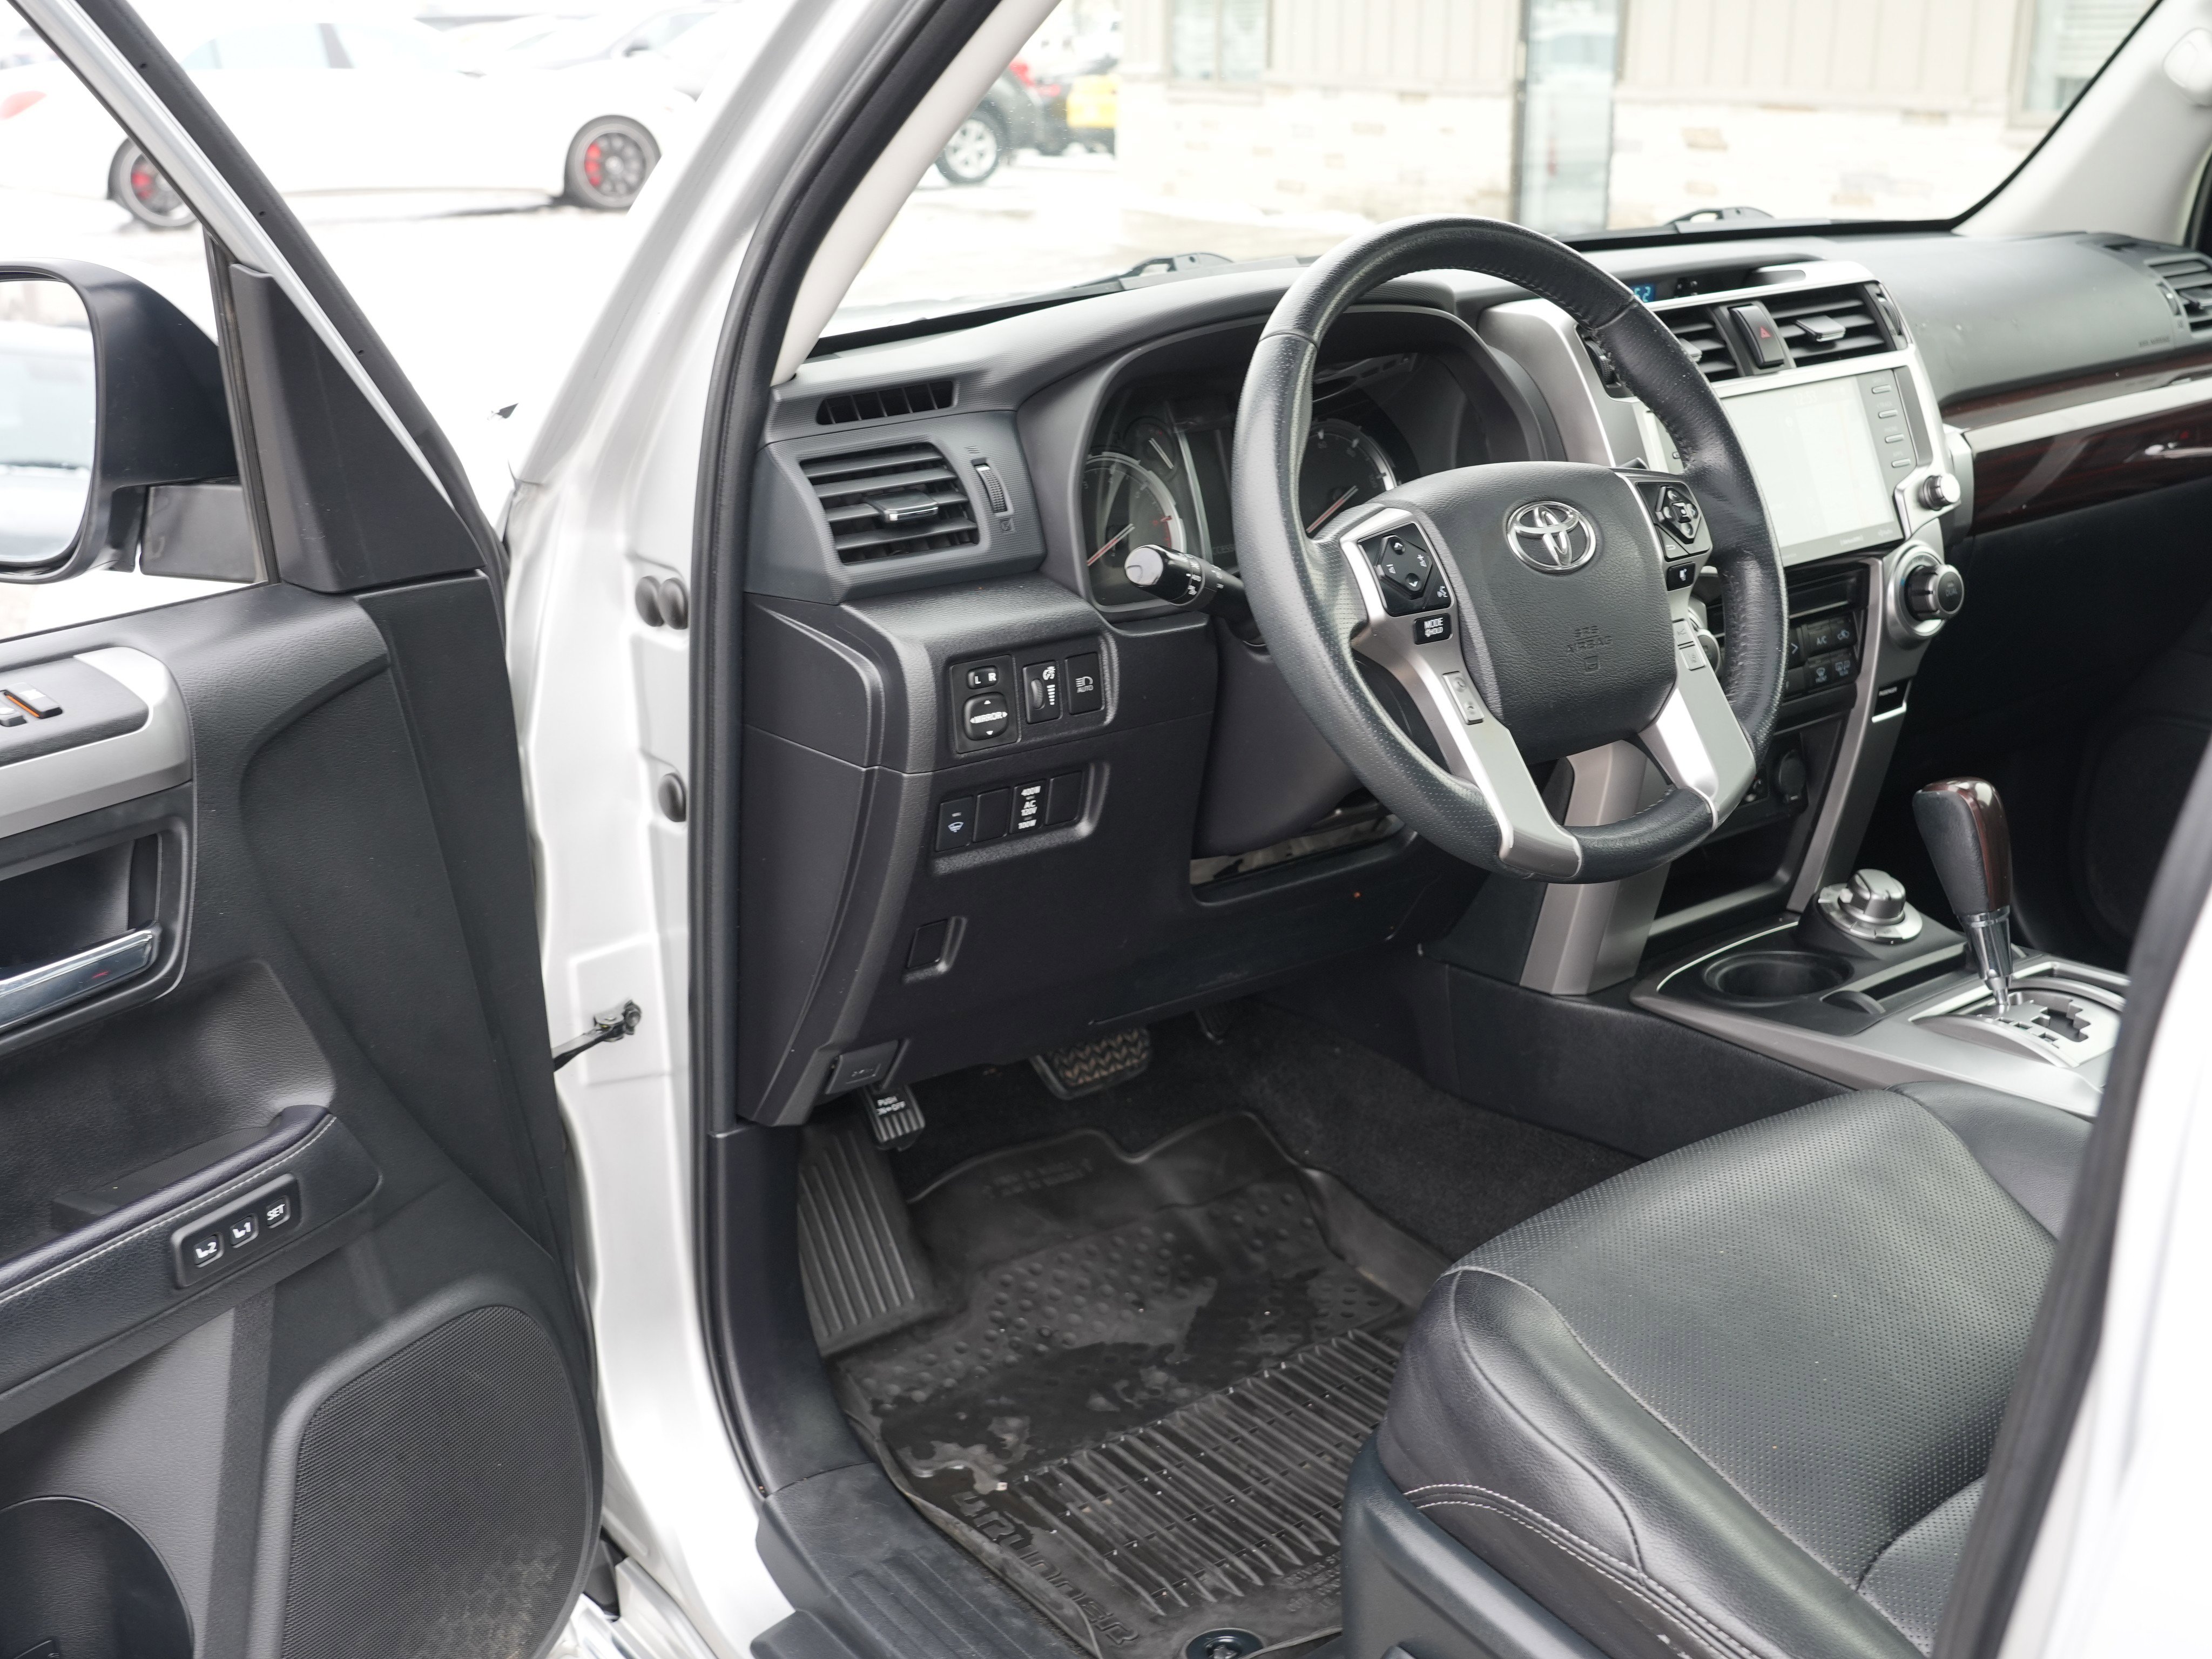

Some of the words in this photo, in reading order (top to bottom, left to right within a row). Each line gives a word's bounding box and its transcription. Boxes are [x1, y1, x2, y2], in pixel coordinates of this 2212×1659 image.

[1424, 617, 1444, 629] MODE
[1567, 635, 1613, 654] AIRBAG
[1816, 635, 1827, 645] A/C
[974, 676, 982, 685] L
[988, 672, 997, 682] R
[1076, 684, 1094, 693] AUTO
[974, 711, 1003, 724] MIRROR
[1023, 800, 1036, 809] AC
[877, 1096, 899, 1107] PUSH
[267, 1204, 286, 1221] SET
